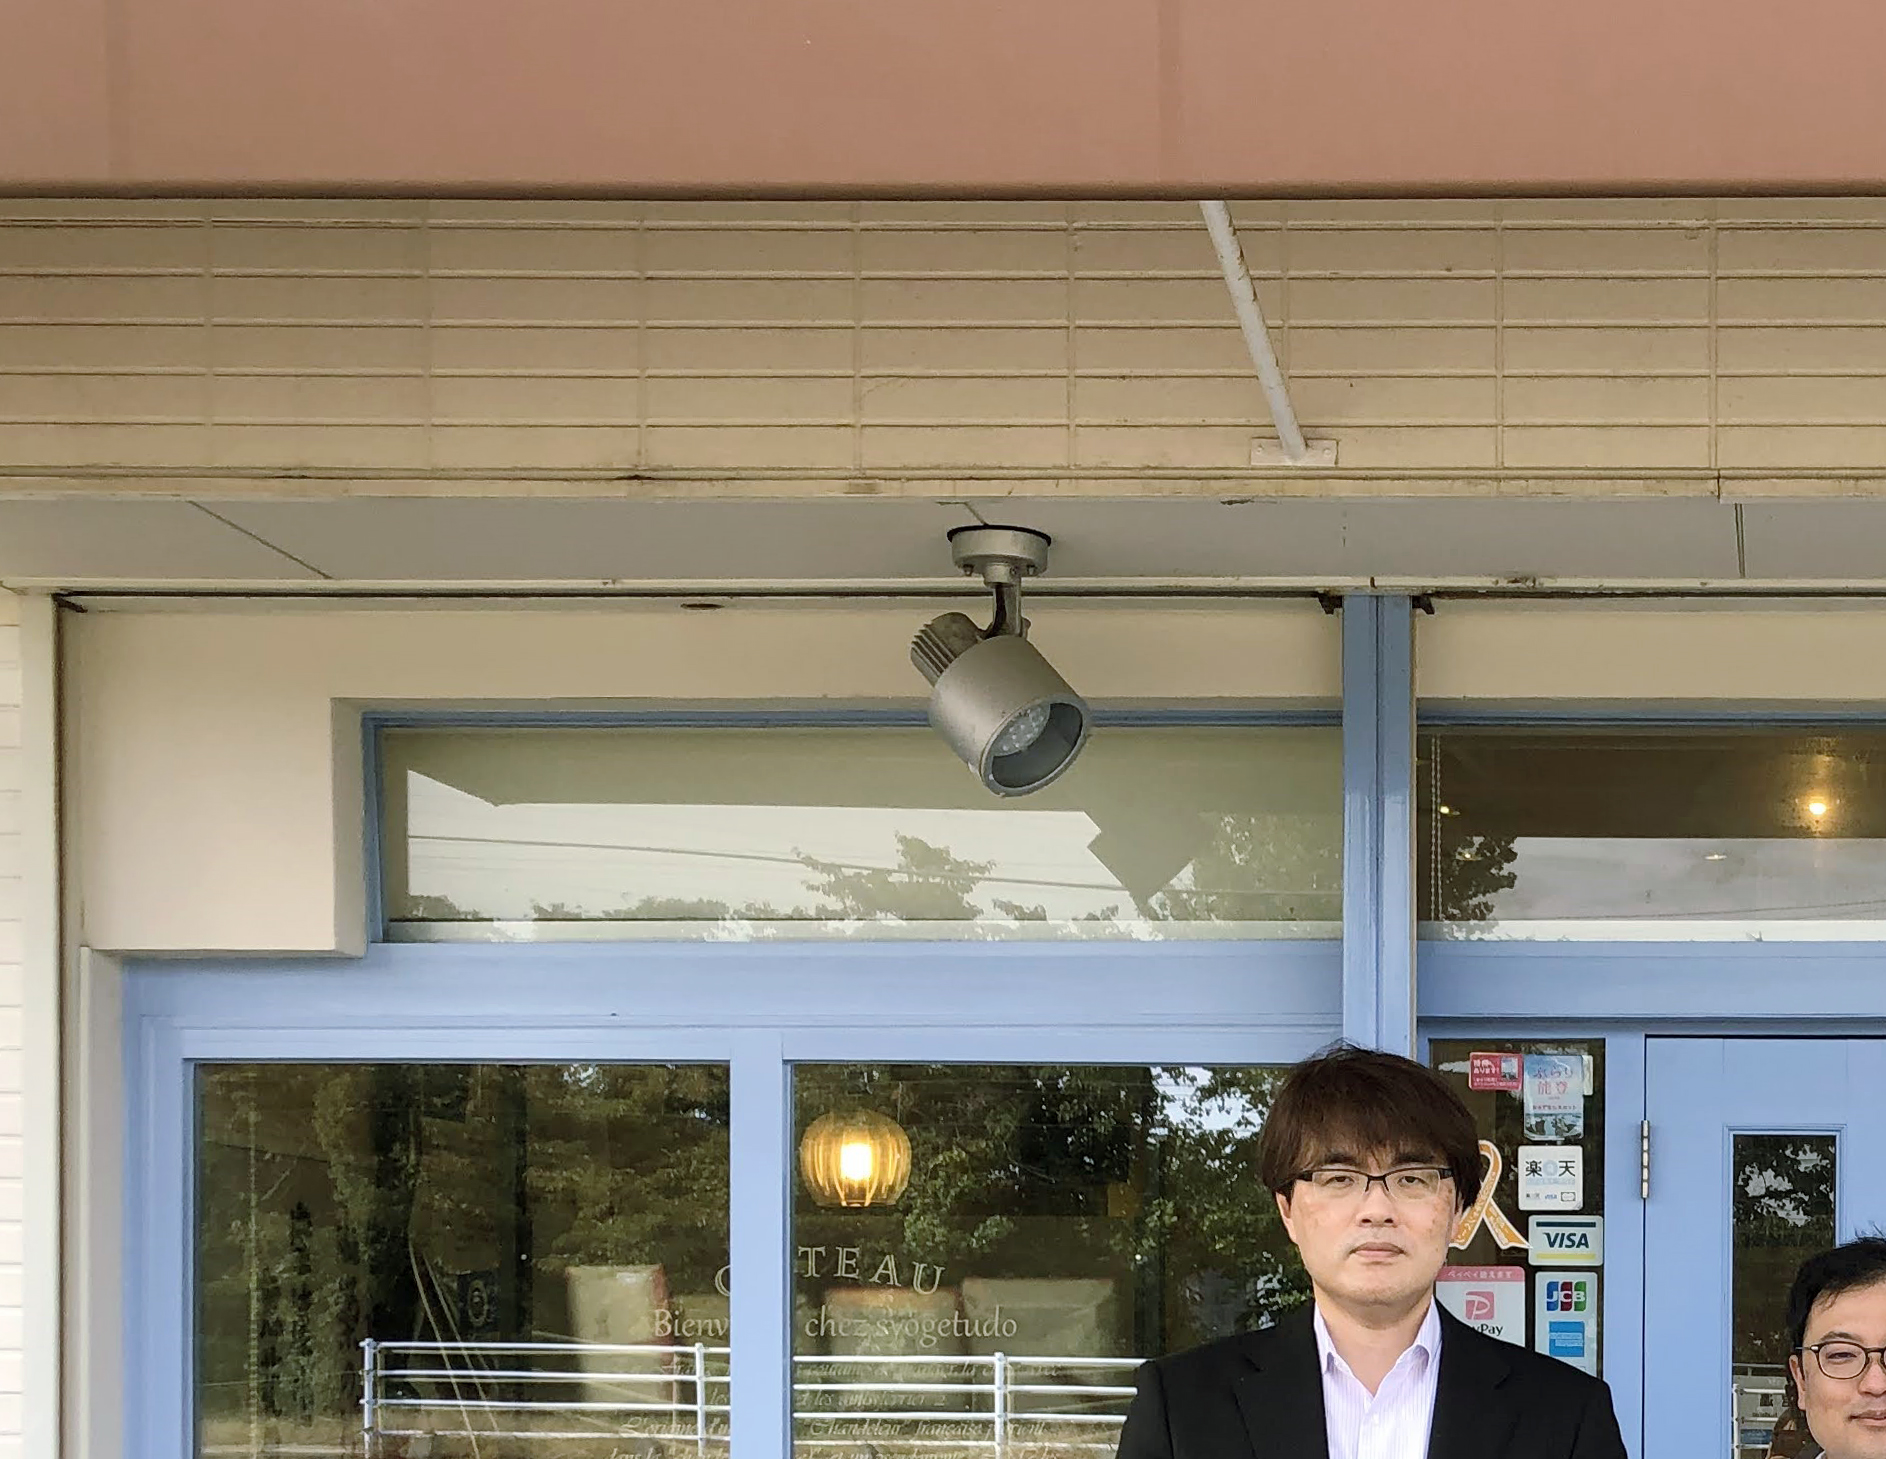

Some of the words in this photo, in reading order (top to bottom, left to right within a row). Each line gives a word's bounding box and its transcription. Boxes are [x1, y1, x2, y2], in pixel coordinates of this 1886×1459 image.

[1543, 1232, 1590, 1249] VISA
[714, 1246, 945, 1296] TEAU
[654, 1309, 730, 1337] Bienv
[804, 1305, 869, 1338] chez
